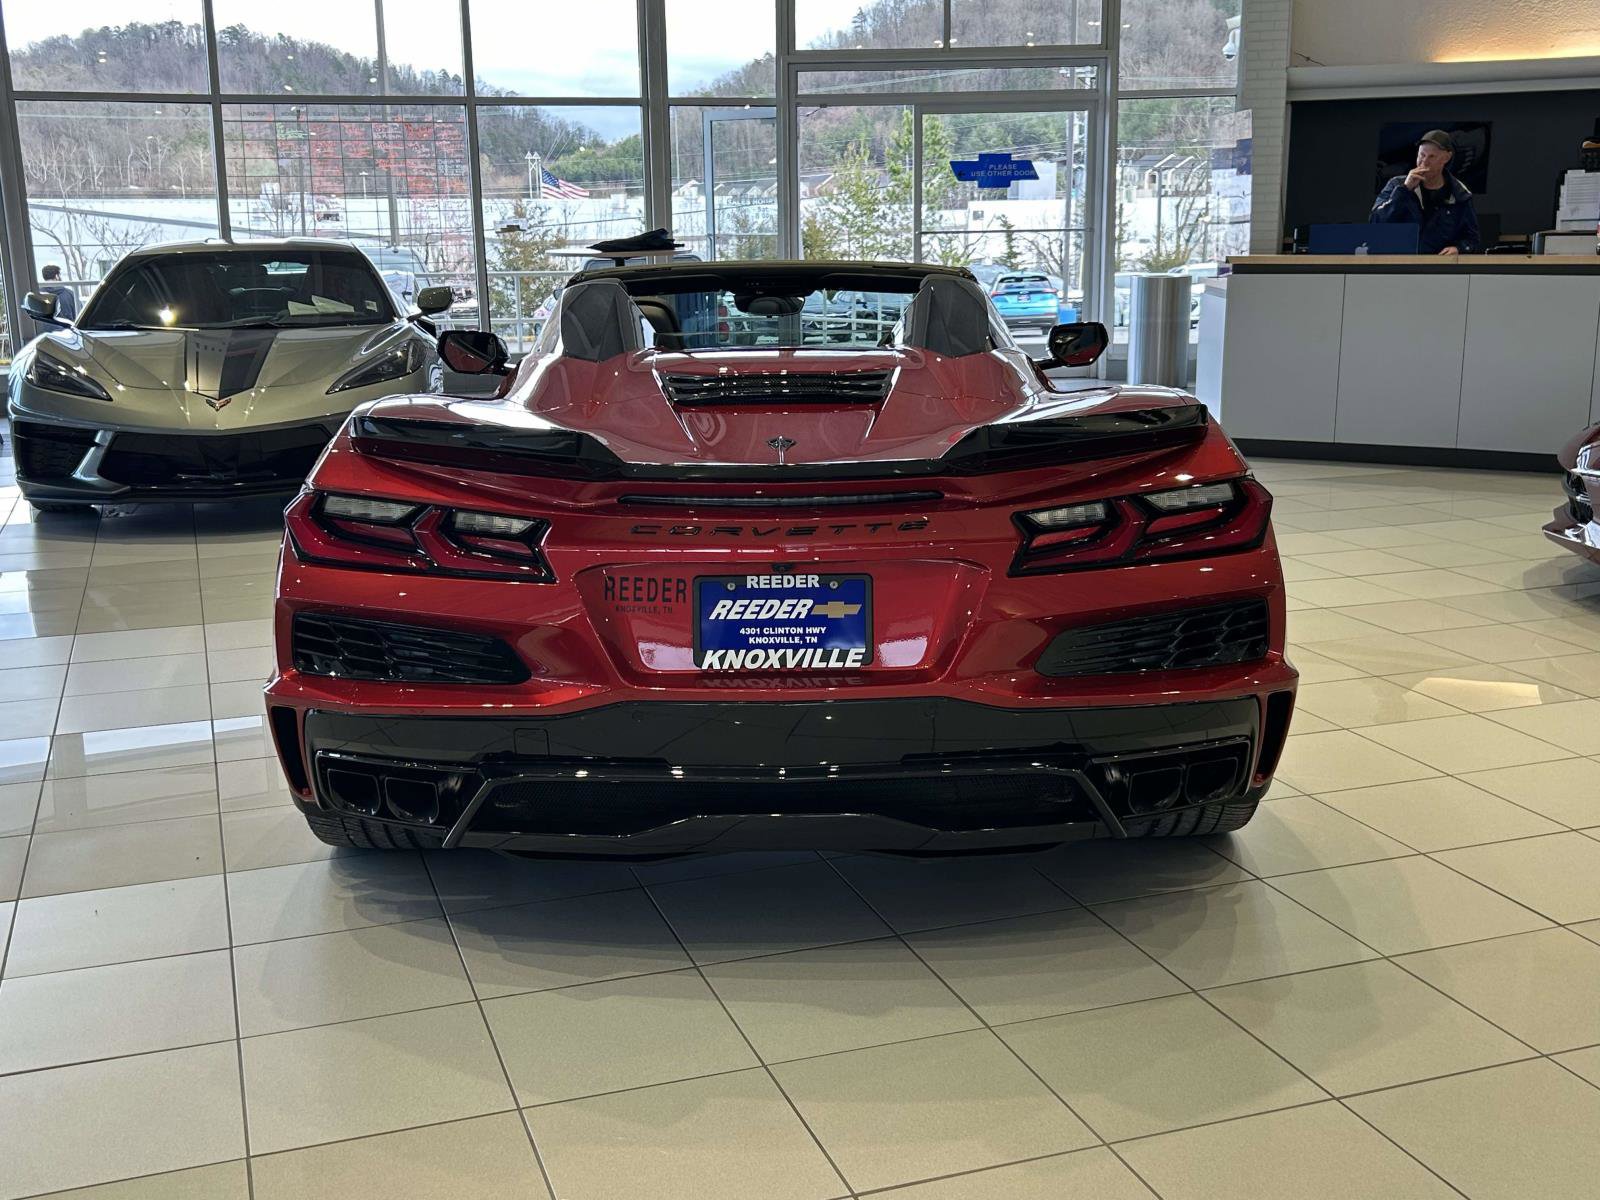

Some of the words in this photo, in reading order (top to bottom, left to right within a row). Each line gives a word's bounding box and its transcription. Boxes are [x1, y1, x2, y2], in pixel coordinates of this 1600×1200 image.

[1014, 169, 1036, 177] DOOR
[629, 520, 931, 536] CORVETTE
[604, 575, 687, 603] REEDER
[746, 574, 820, 589] REEDER
[708, 598, 814, 620] REEDER
[739, 627, 760, 635] 4301
[763, 627, 804, 635] CLINTON
[805, 626, 827, 634] HWY
[749, 636, 803, 644] KNOXVILLE,
[805, 636, 818, 644] TN
[701, 648, 866, 670] KNOXVILLE
